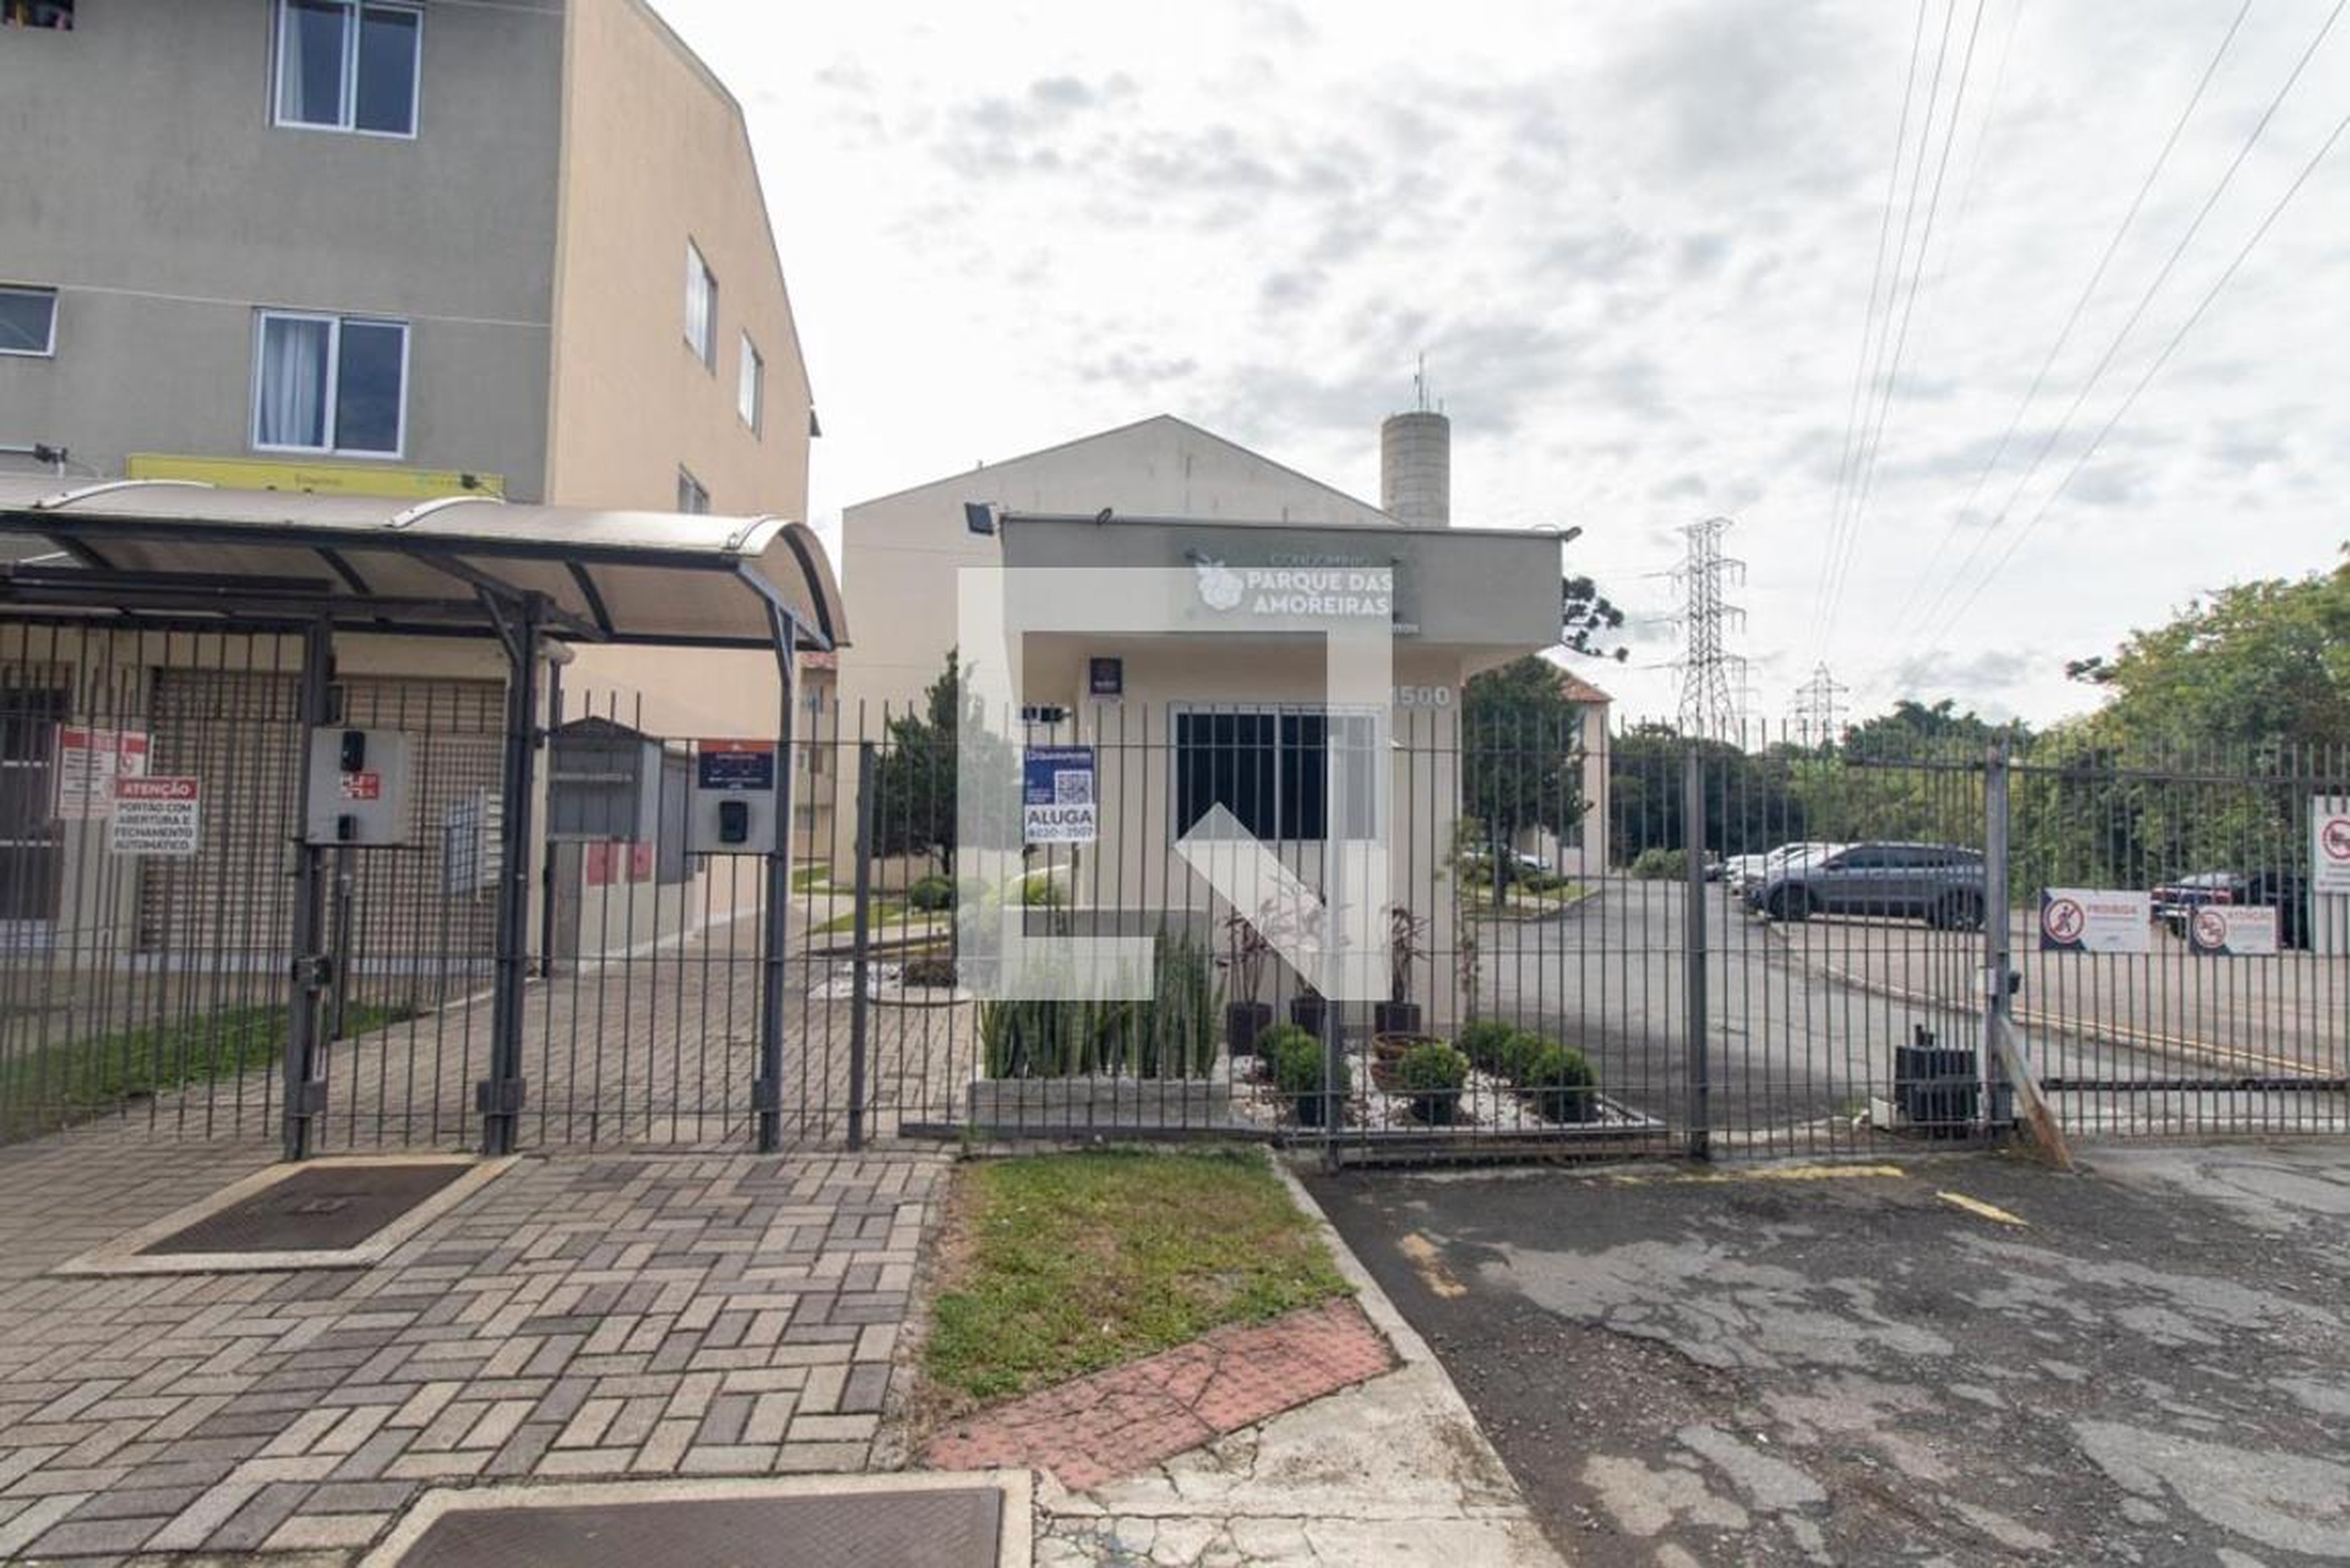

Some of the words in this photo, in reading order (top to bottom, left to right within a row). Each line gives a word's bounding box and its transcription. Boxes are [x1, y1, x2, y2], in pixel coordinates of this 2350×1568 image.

[1247, 570, 1341, 595] PARQUE
[1348, 573, 1392, 592] DAS
[1253, 594, 1390, 615] AMOREIRAS
[124, 780, 189, 797] ATENÇÃO
[166, 802, 192, 813] COM
[1028, 810, 1092, 826] ALUGA
[114, 826, 193, 838] FECHAMENTO
